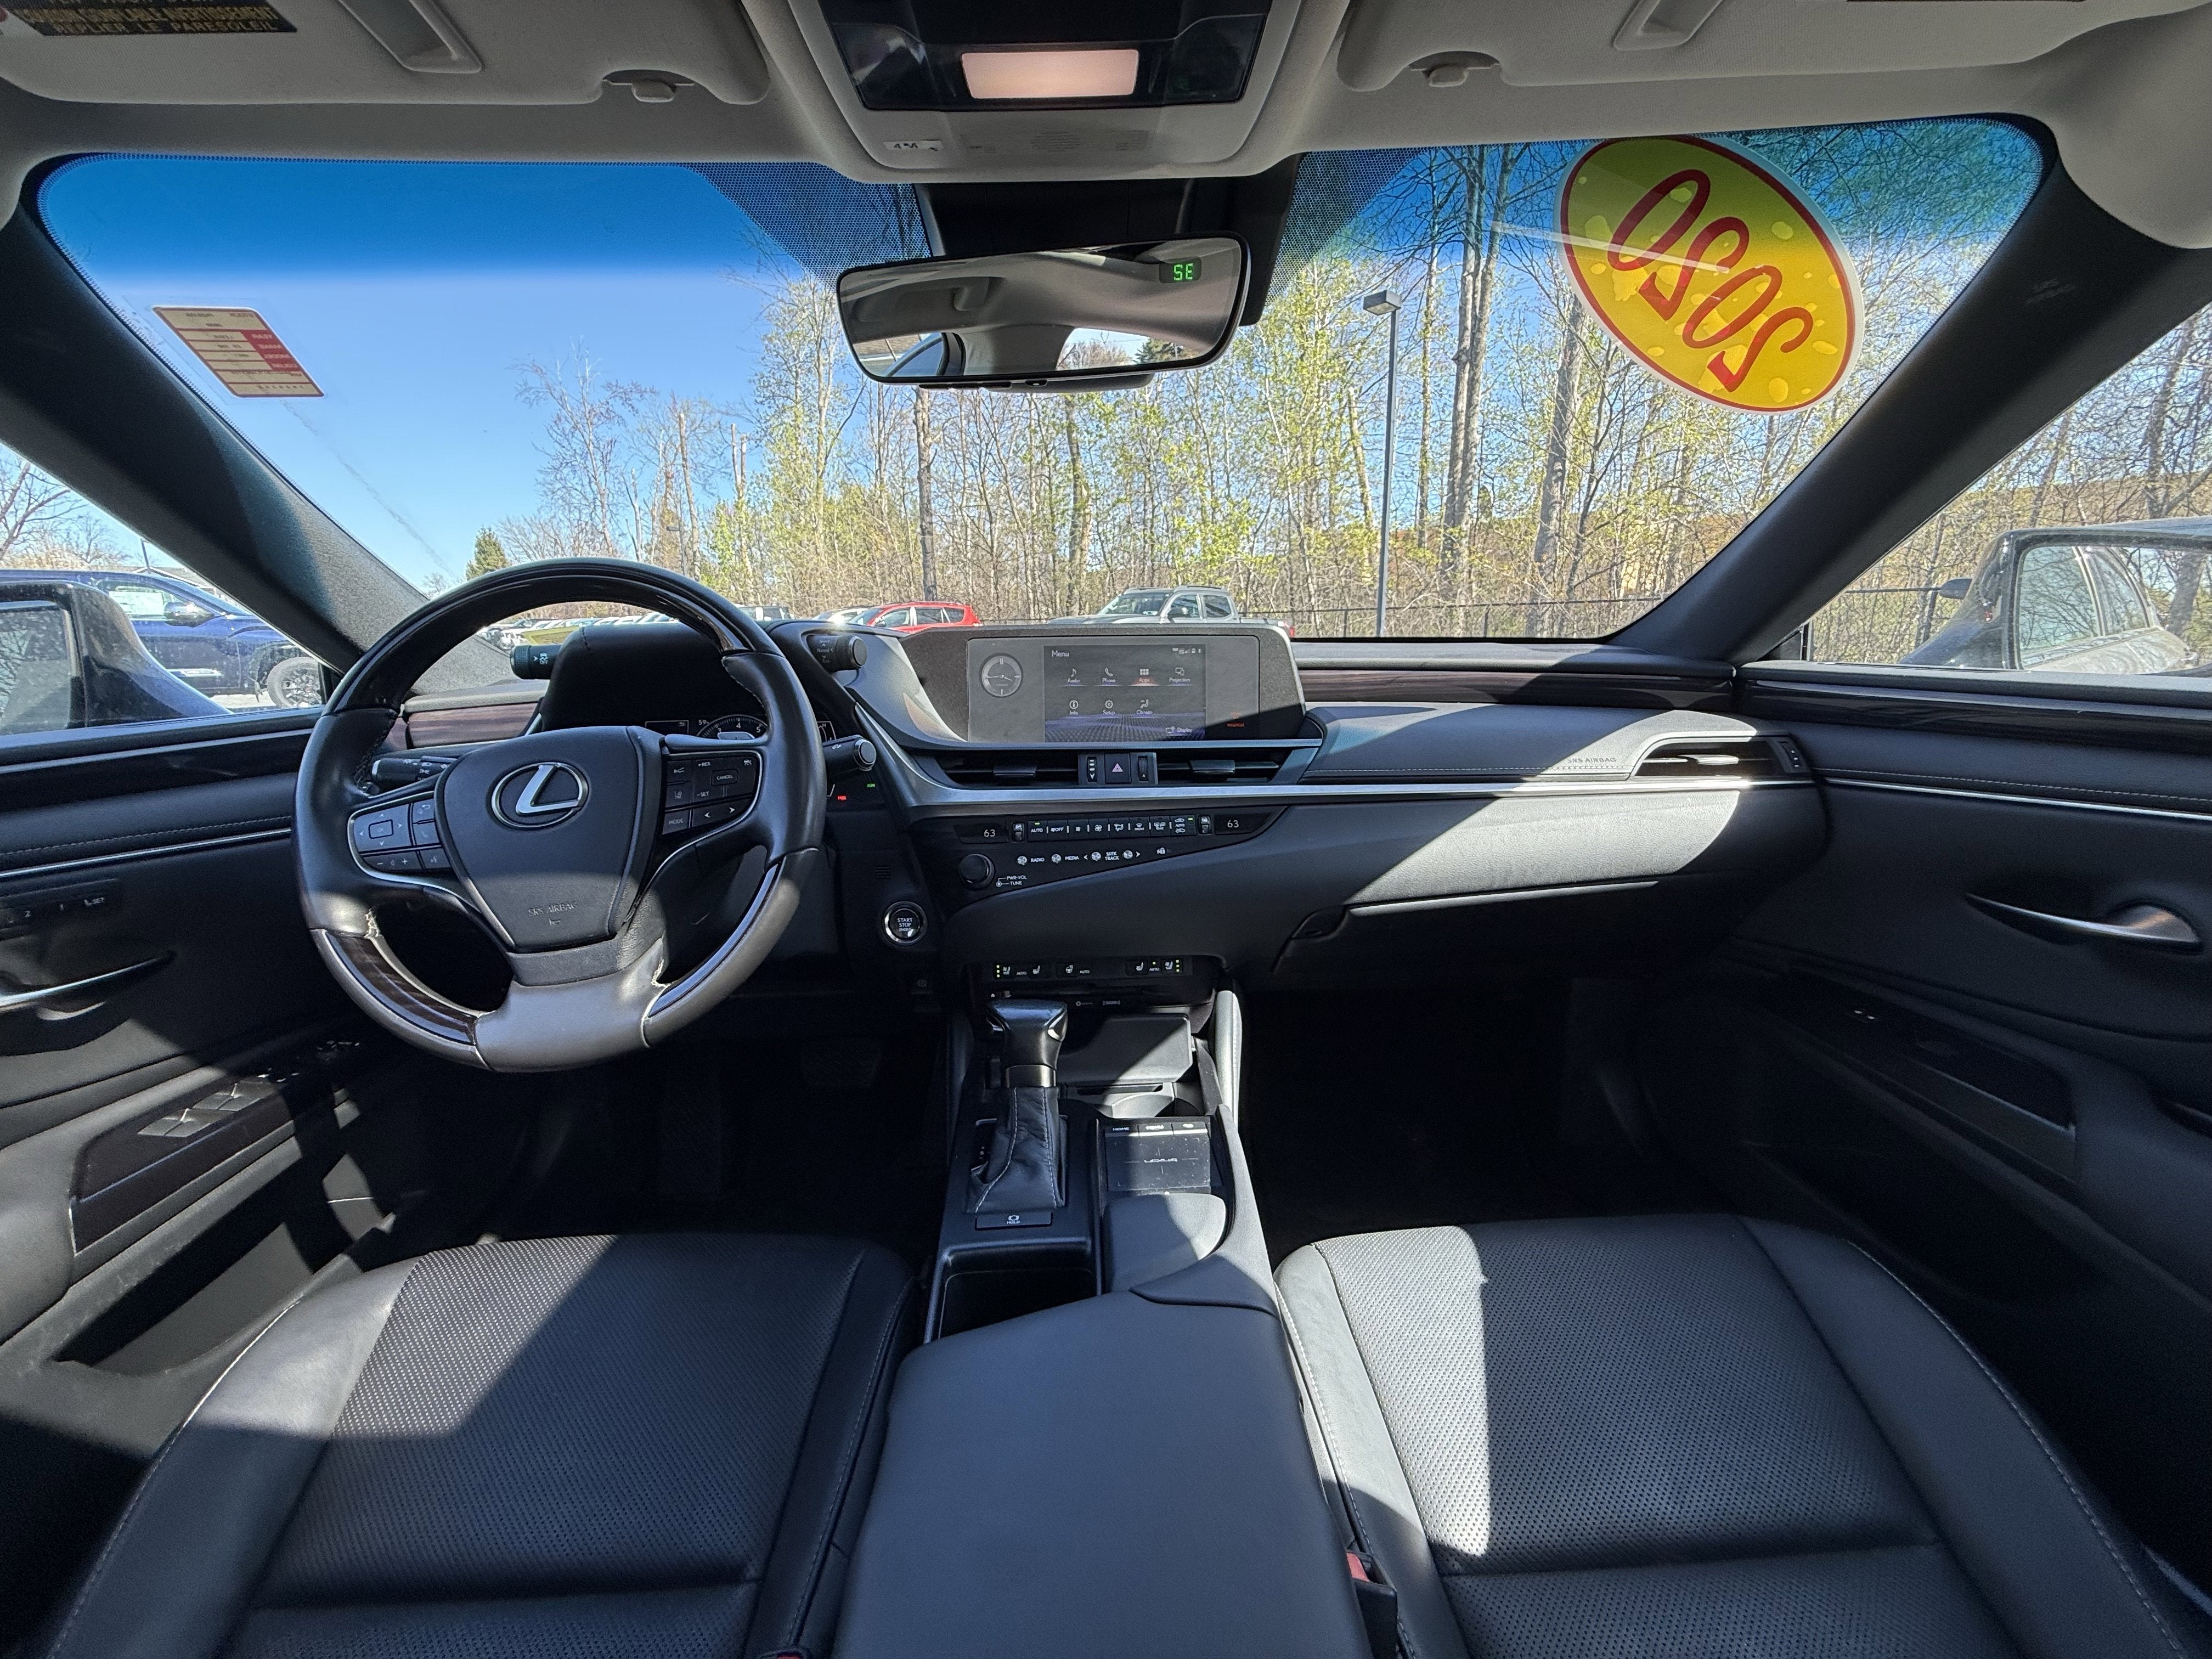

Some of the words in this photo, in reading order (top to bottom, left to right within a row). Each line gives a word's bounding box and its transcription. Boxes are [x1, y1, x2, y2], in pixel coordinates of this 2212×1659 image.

[170, 20, 279, 32] PARESOLEIL
[1173, 263, 1193, 281] SE
[1227, 820, 1240, 828] 63
[984, 829, 996, 837] 63
[548, 901, 579, 913] AIRBAG
